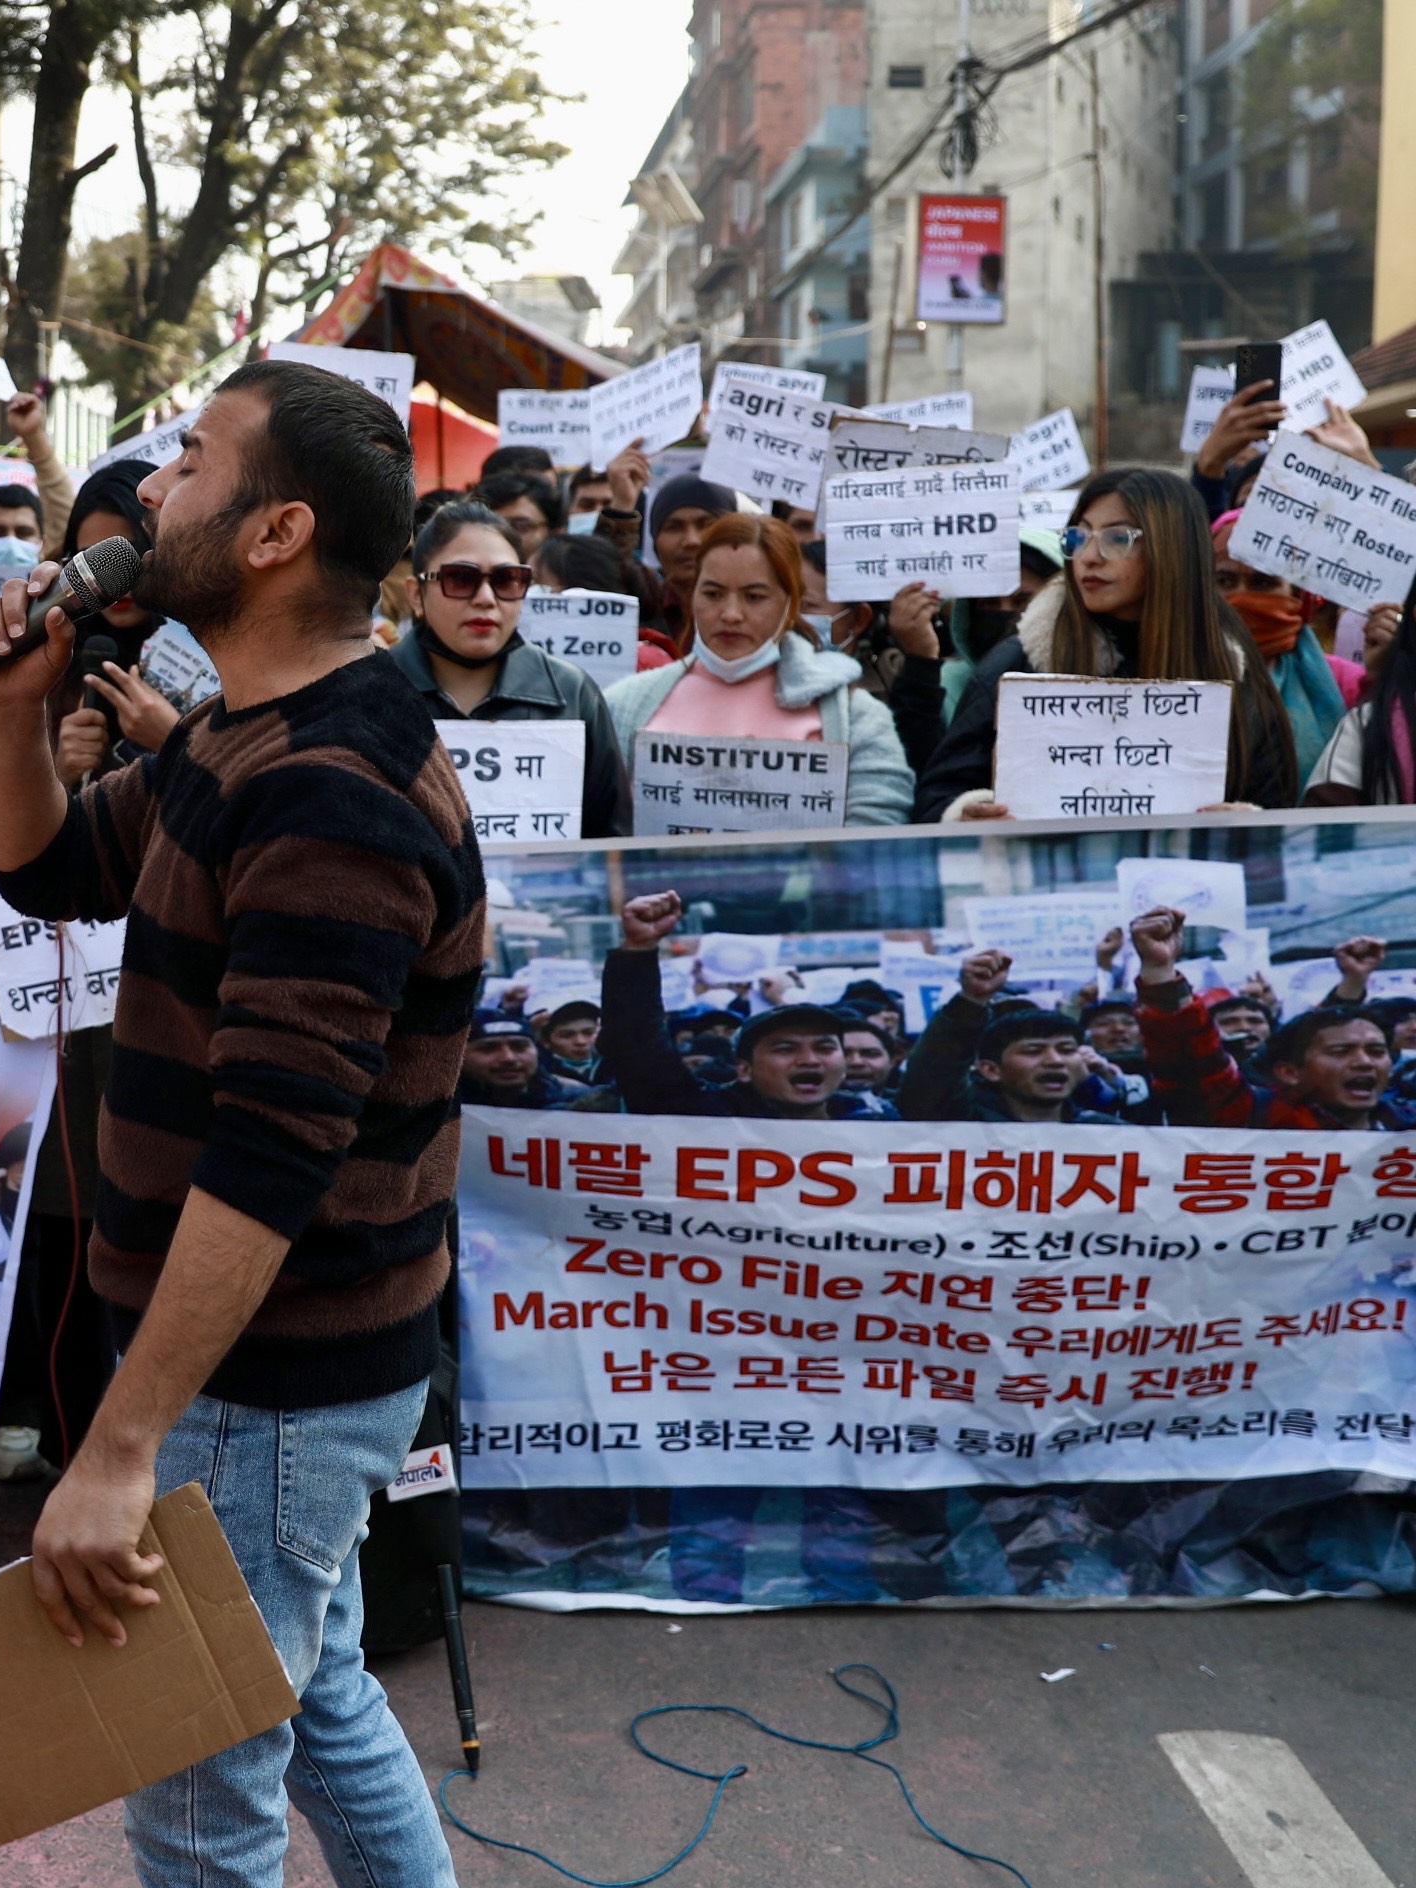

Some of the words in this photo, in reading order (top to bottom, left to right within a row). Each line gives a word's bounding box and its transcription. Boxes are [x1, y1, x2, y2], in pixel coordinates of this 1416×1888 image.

[729, 387, 785, 416] agri
[507, 421, 554, 434] Count
[835, 439, 913, 471] रोस्टर
[1283, 452, 1364, 501] Company
[1369, 484, 1390, 506] मा
[1390, 496, 1416, 523] file
[843, 522, 883, 541] तलब
[889, 516, 924, 538] खाने
[934, 512, 997, 536] HRD
[1252, 530, 1274, 552] मा
[1352, 528, 1414, 566] Roster
[856, 554, 889, 578] लाई
[962, 553, 988, 571] गर
[578, 598, 625, 616] Job
[563, 636, 623, 656] Zero
[446, 746, 502, 782] PS
[515, 754, 545, 779] मा
[650, 742, 829, 774] INSTITUTE
[1048, 744, 1104, 767] भन्दा
[642, 780, 684, 806] लाई
[693, 787, 792, 811] मालामाल
[531, 812, 571, 838] गर
[1, 920, 59, 950] EPS
[488, 1135, 651, 1198] 네팔
[675, 1146, 857, 1207] EPS
[883, 1149, 1150, 1214] 피해자
[1174, 1151, 1351, 1214] 통합
[1241, 1223, 1338, 1255] CBT
[565, 1236, 723, 1285] Zero
[741, 1256, 863, 1300] File
[880, 1269, 993, 1313] 지연
[1011, 1275, 1151, 1314] 중단!
[493, 1291, 669, 1331] March
[689, 1298, 839, 1342] Issue
[854, 1313, 990, 1354] Date
[1006, 1317, 1243, 1360] 우리에게도
[1255, 1298, 1407, 1347] 주세요!
[603, 1349, 716, 1393] 남은
[733, 1354, 845, 1395] 모든
[862, 1356, 977, 1402] 파일
[995, 1372, 1108, 1409] 즉시
[1127, 1361, 1258, 1399] 진행!
[655, 1419, 814, 1454] 평화로운
[827, 1422, 938, 1455] 시위를
[954, 1427, 1036, 1458] 통해
[1045, 1417, 1155, 1454] 우리의
[1165, 1408, 1318, 1440] 목소리를
